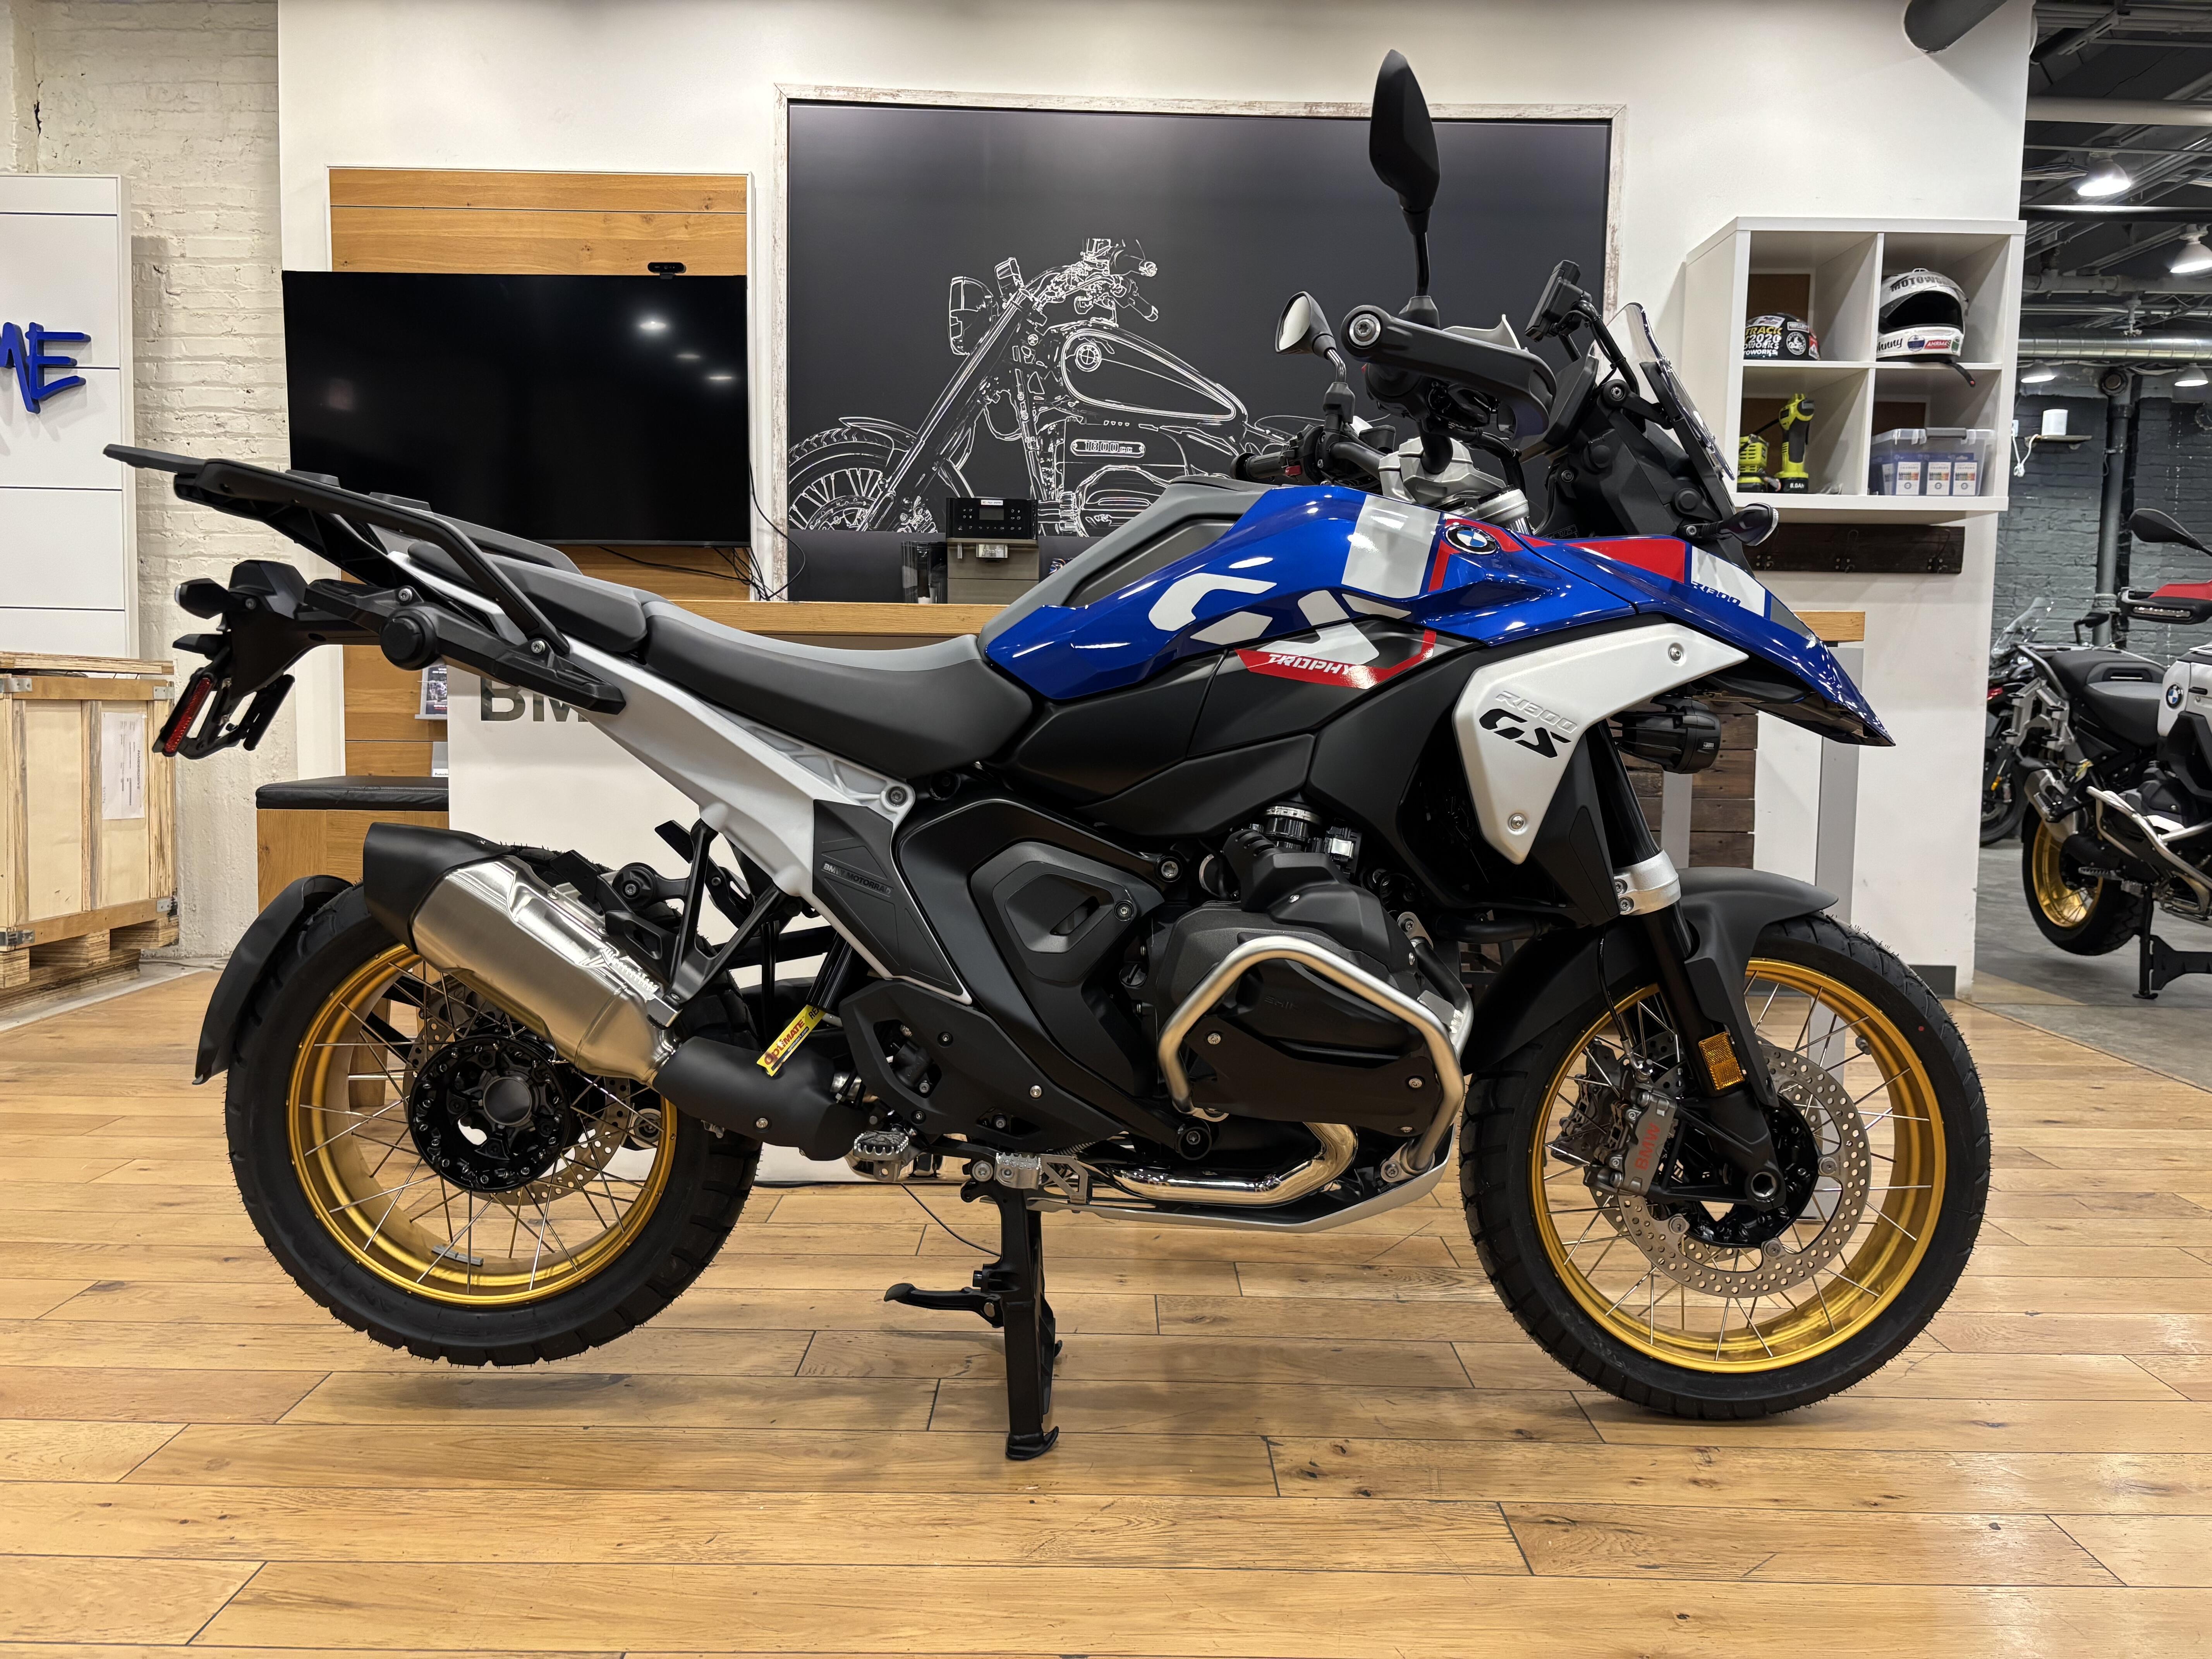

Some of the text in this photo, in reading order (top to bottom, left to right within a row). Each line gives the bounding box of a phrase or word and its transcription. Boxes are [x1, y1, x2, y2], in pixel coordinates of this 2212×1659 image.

[1269, 654, 1353, 675] TROPHY
[1479, 708, 1572, 758] GS
[1495, 690, 1578, 733] R1300
[847, 872, 891, 894] MOTORRAD
[1635, 1122, 1661, 1171] BMW
